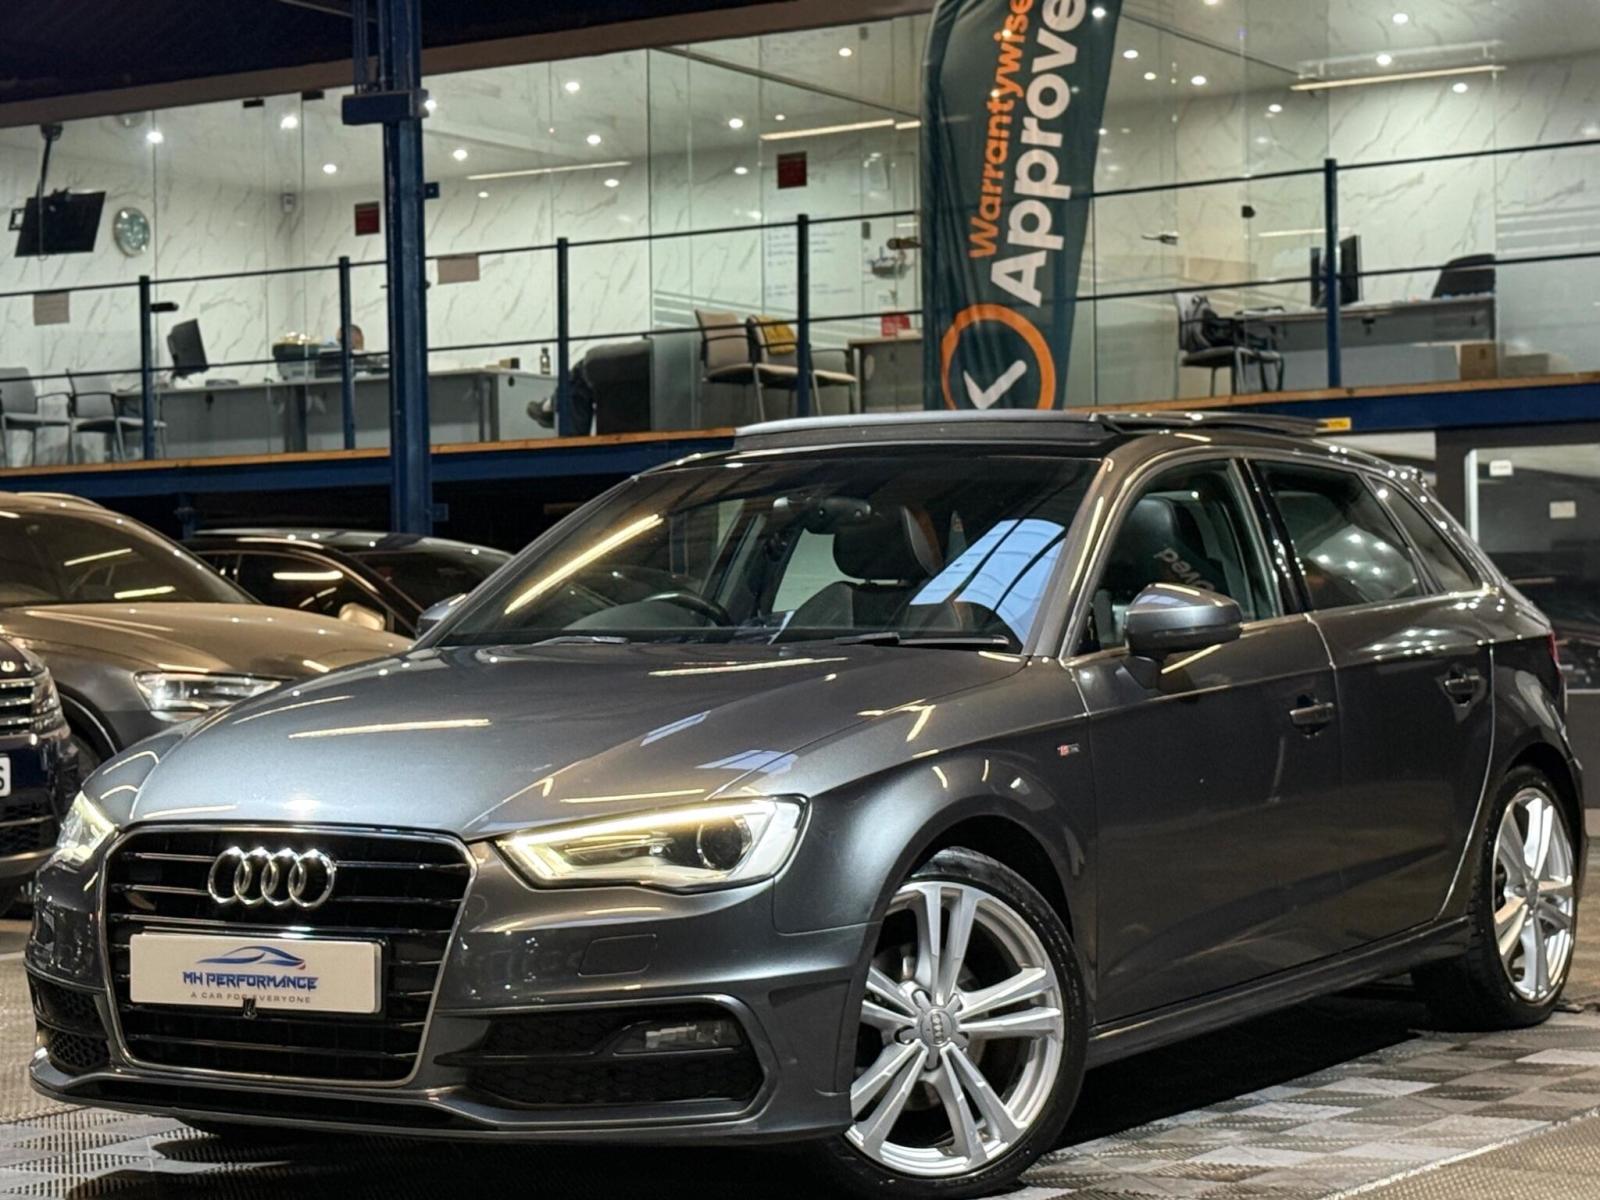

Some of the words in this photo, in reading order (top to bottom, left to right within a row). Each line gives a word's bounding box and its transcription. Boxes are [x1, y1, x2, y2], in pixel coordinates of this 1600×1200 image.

[968, 0, 1034, 258] Warrantywise
[183, 972, 203, 986] MH
[206, 973, 319, 991] PERFORMANCE
